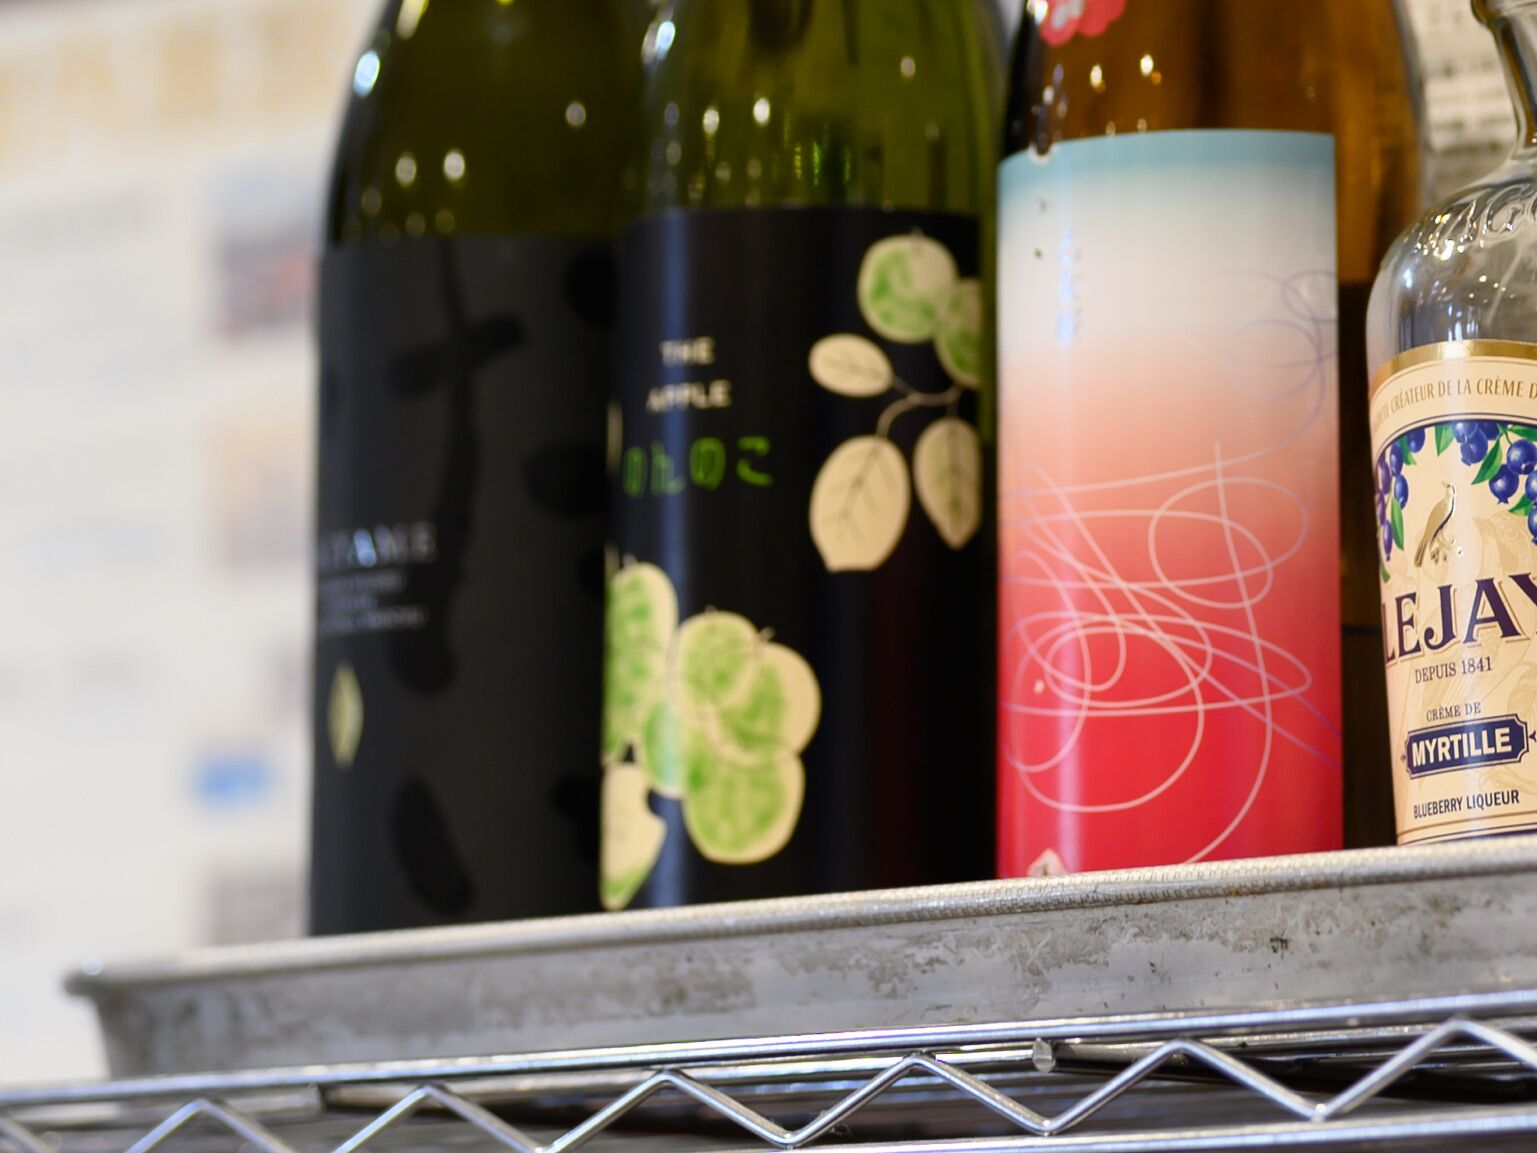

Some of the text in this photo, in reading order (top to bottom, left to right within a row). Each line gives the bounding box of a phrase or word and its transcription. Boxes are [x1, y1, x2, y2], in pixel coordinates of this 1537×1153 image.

[660, 336, 716, 366] THE
[646, 378, 732, 414] APPLE
[1438, 380, 1454, 397] DE
[1458, 378, 1472, 395] LA
[1477, 375, 1523, 396] CRÈME
[1415, 656, 1493, 684] DEPUIS 1841
[1426, 702, 1482, 722] CRÈME DE
[1411, 727, 1512, 767] MYRTILLE
[1413, 789, 1520, 819] BLUEBERRY LIQUEUR
